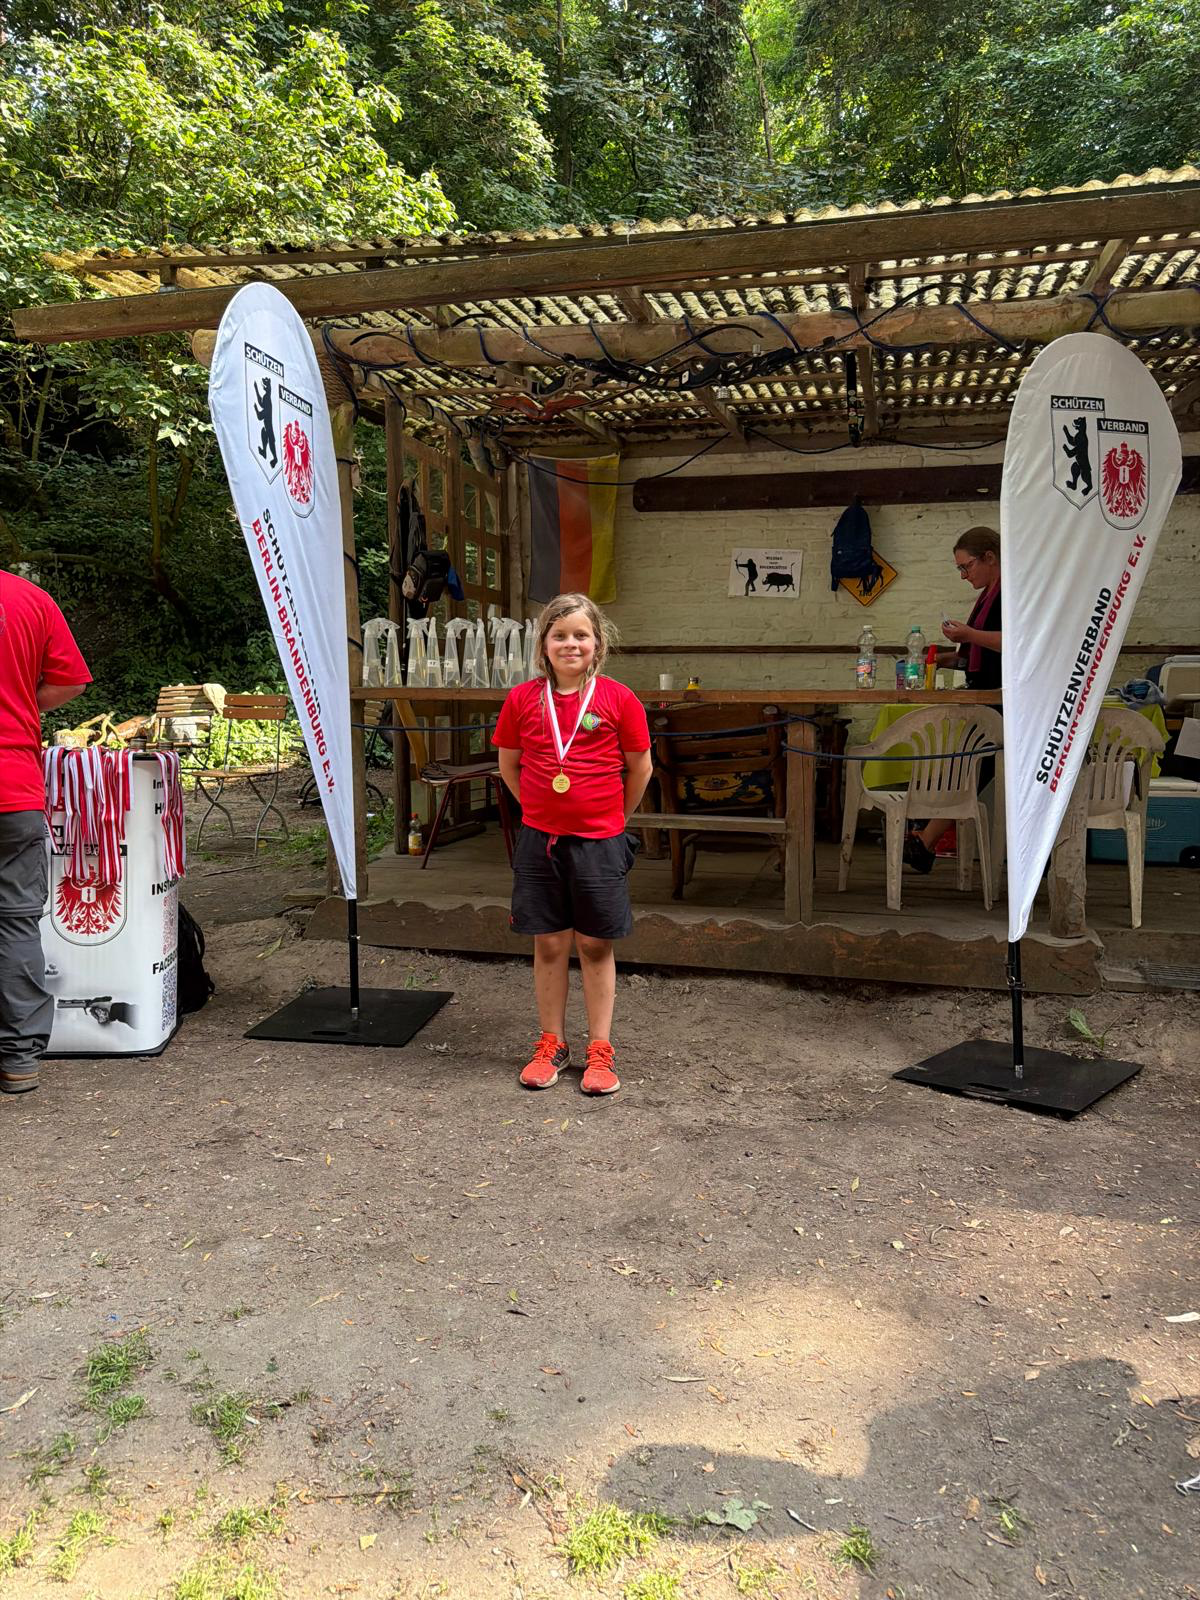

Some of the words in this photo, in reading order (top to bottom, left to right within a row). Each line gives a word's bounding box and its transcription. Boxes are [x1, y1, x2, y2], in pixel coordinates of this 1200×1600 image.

[246, 345, 283, 377] SCHÜTZEN
[280, 387, 311, 415] VERBAND
[1052, 397, 1103, 411] SCHÜTZEN
[1100, 420, 1146, 433] VERBAND
[1127, 533, 1147, 568] E.V.
[251, 518, 328, 757] BERLIN-BRANDENBURG
[322, 758, 337, 794] E.V.
[1036, 586, 1112, 785] SCHÜTZENVERBAND
